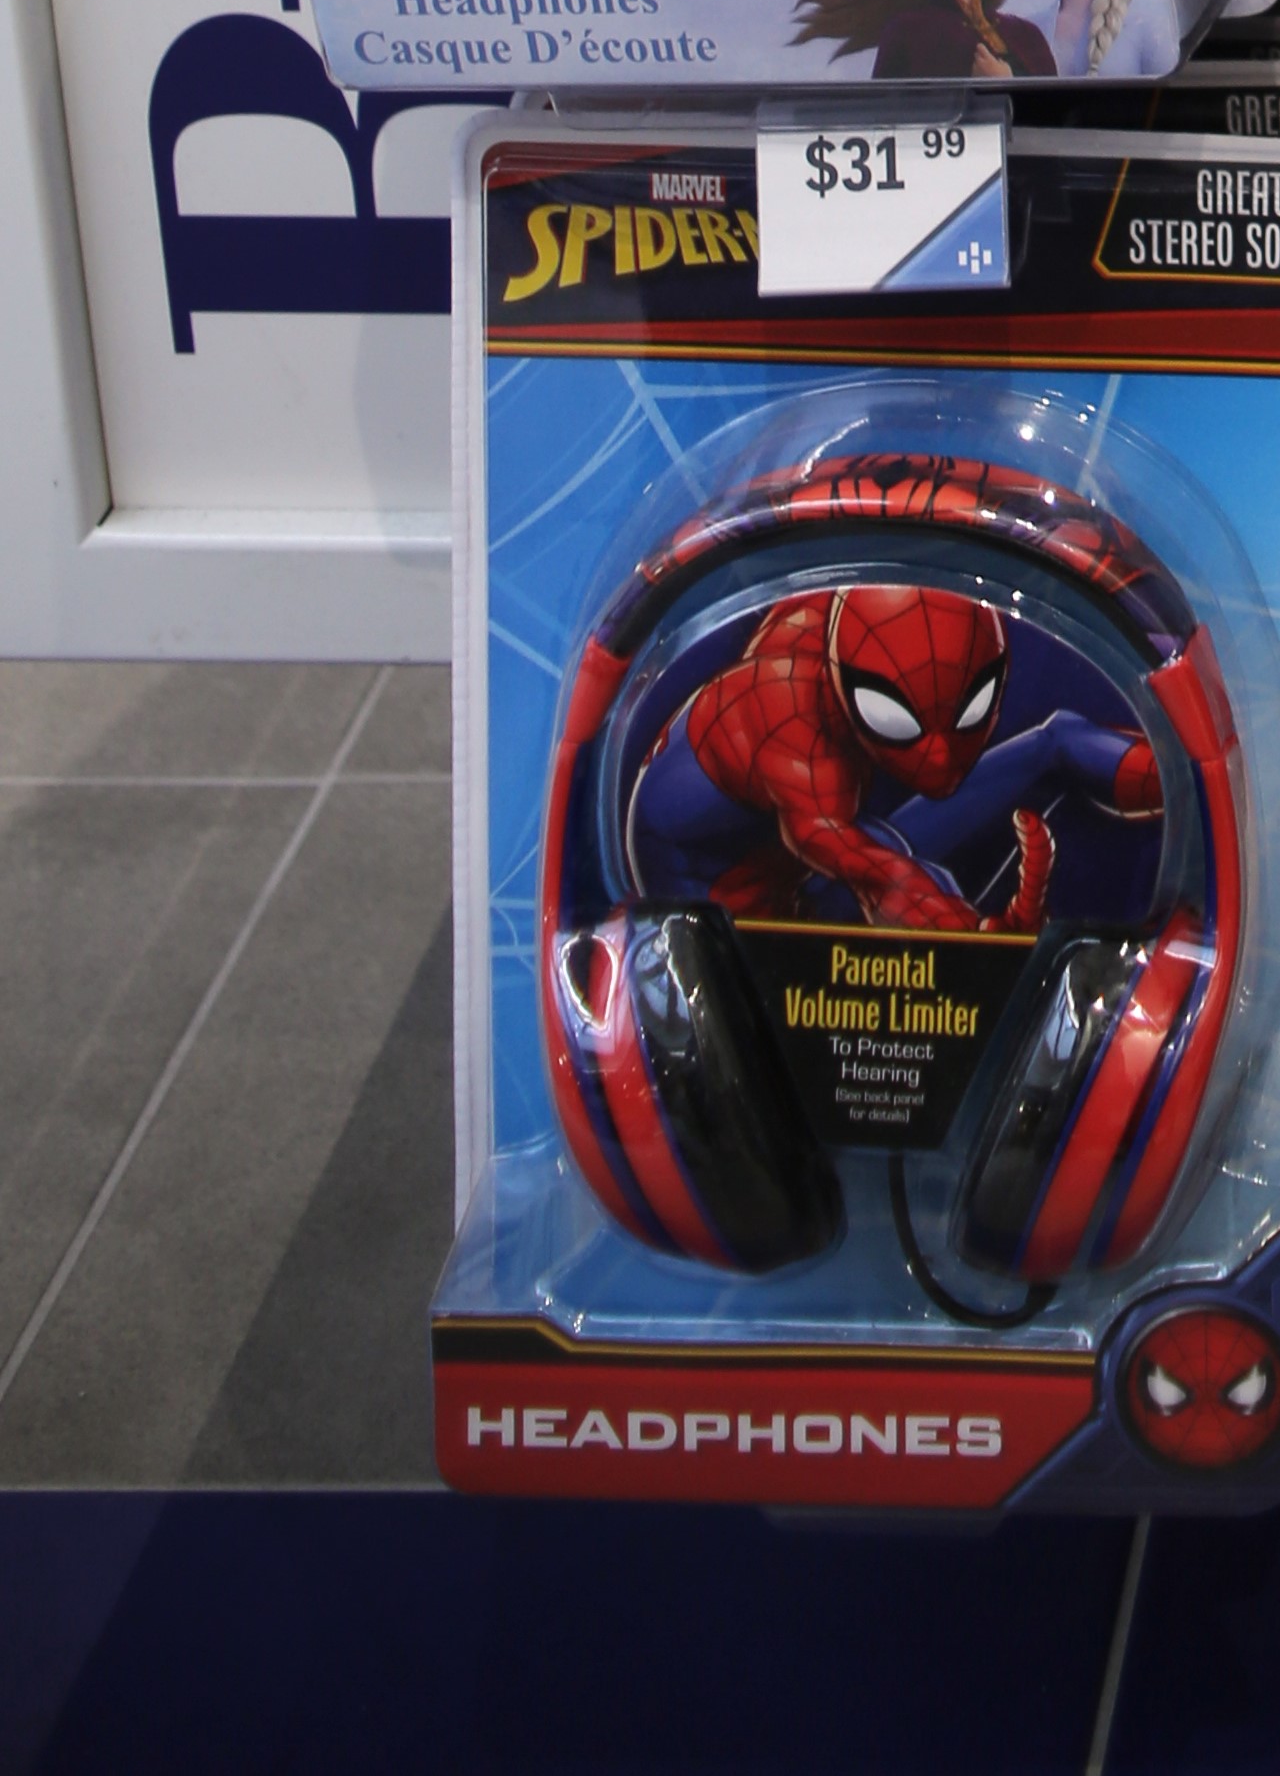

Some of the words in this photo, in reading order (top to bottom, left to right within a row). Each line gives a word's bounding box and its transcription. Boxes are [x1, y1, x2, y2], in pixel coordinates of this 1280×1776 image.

[353, 31, 512, 74] Casque
[523, 29, 717, 65] D'écoute
[805, 132, 906, 198] $31
[922, 127, 966, 160] 99
[651, 172, 725, 202] MARVEL
[1128, 220, 1233, 267] STEREO
[831, 945, 935, 989] Parental
[786, 987, 879, 1030] Volume
[889, 994, 978, 1037] Limiter
[467, 1406, 1003, 1458] HEADPHONES
